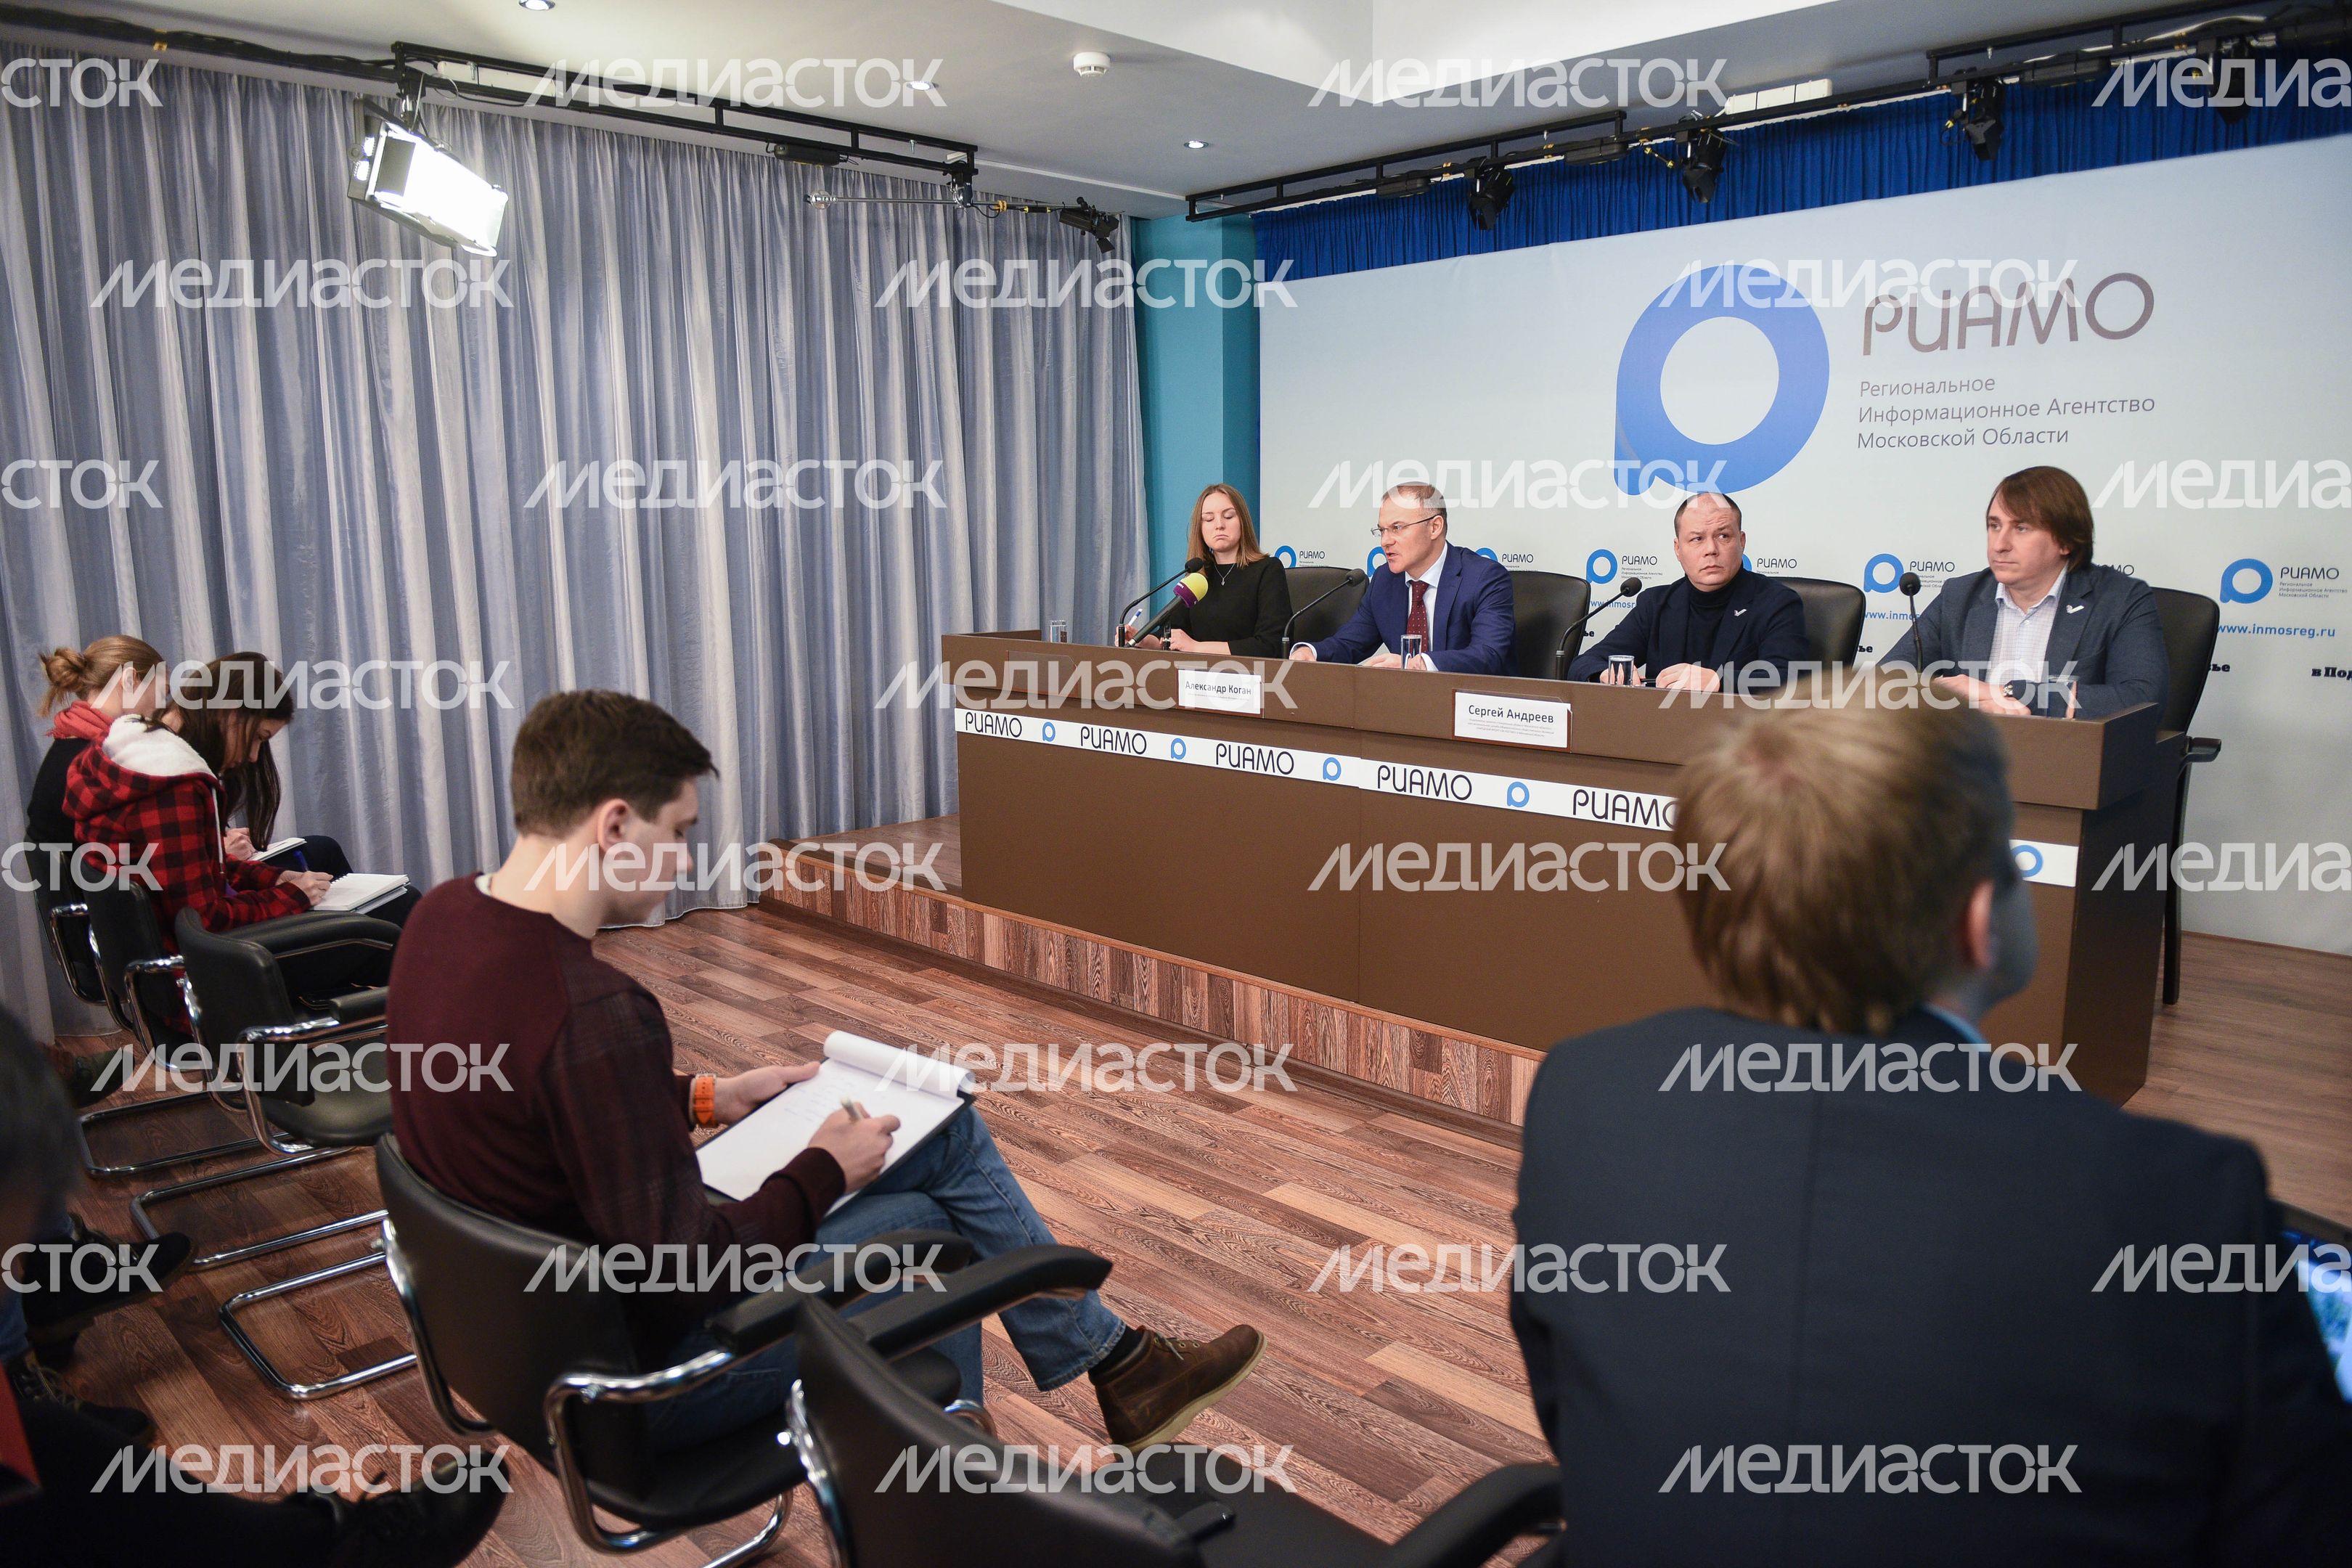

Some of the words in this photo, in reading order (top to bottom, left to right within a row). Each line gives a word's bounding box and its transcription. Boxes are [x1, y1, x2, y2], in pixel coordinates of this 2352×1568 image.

[1863, 272, 2155, 356] РИАМО
[1860, 376, 1996, 397] Региональное
[1858, 401, 2040, 426] Информационное
[2046, 397, 2155, 416] Агентство
[1858, 428, 1975, 449] Московской
[1983, 428, 2069, 446] Области
[1299, 550, 1326, 559] РИАМО
[1502, 553, 1534, 563] РИАМО
[1622, 555, 1658, 565] РИАМО
[1757, 558, 1797, 568] РИАМО
[1909, 560, 1956, 572] РИАМО
[2280, 566, 2340, 580] РИАМО
[1185, 680, 1227, 694] Александр
[1228, 685, 1252, 695] Коган
[1469, 705, 1503, 718] Сергей
[1507, 709, 1554, 723] Андреев
[965, 711, 1022, 738] РИАМО
[1080, 726, 1147, 755] РИАМО
[1216, 743, 1294, 775] РИАМО
[1377, 764, 1472, 801] РИАМО
